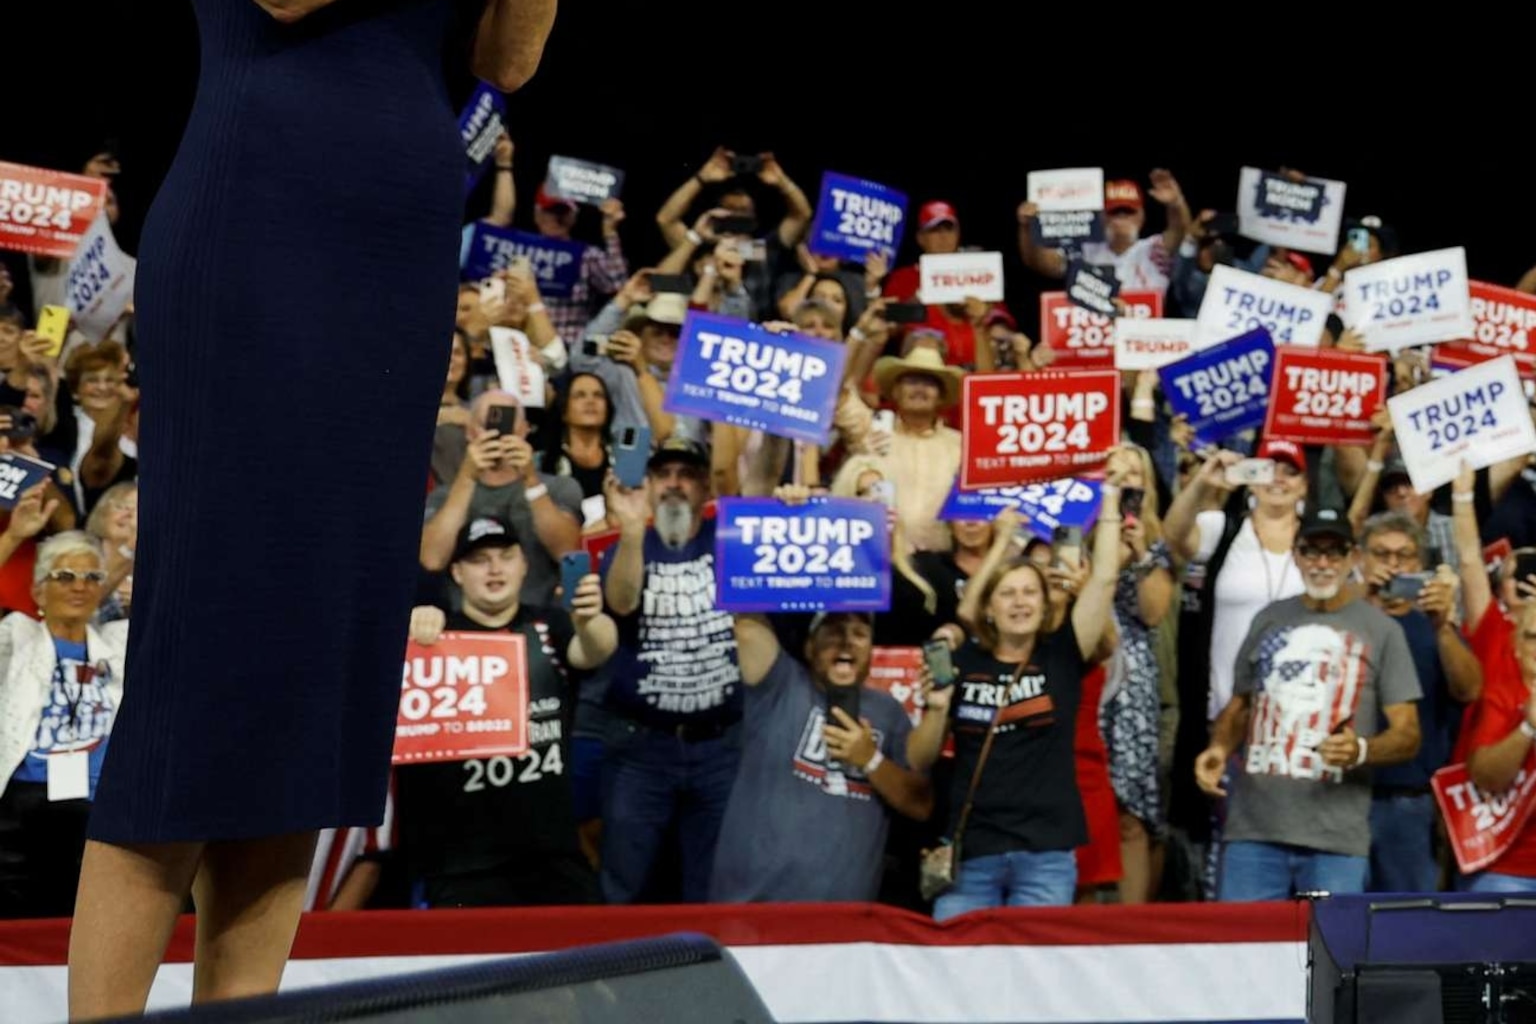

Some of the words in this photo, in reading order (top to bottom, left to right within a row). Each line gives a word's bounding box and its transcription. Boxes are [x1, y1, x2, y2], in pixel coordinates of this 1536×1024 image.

[461, 92, 493, 142] UMP
[831, 188, 903, 226] TRUMP
[483, 234, 573, 268] TRUMP
[931, 273, 995, 288] TRUMP
[1359, 269, 1452, 302] TRUMP
[1052, 304, 1152, 328] TRUP
[1223, 286, 1314, 325] TRUMP
[1373, 293, 1440, 320] 2024
[1066, 326, 1116, 349] 202
[1124, 339, 1189, 353] TRUMP
[1474, 321, 1528, 351] 024
[697, 331, 827, 382] TRUMP
[705, 361, 803, 404] 2024
[1173, 348, 1270, 399] TRUMP
[1285, 366, 1377, 397] TRUMP
[978, 392, 1109, 425] TRUMP
[1196, 376, 1268, 417] 2024
[1292, 391, 1362, 418] 2024
[1408, 381, 1505, 432] TRUMP
[996, 421, 1091, 453] 2024
[1428, 409, 1497, 451] 2024
[734, 516, 873, 546] TRUMP
[753, 544, 855, 574] 2024
[400, 685, 487, 721] 024
[962, 674, 1047, 707] TRUMP
[396, 723, 440, 736] RUMP
[463, 743, 564, 792] 2024
